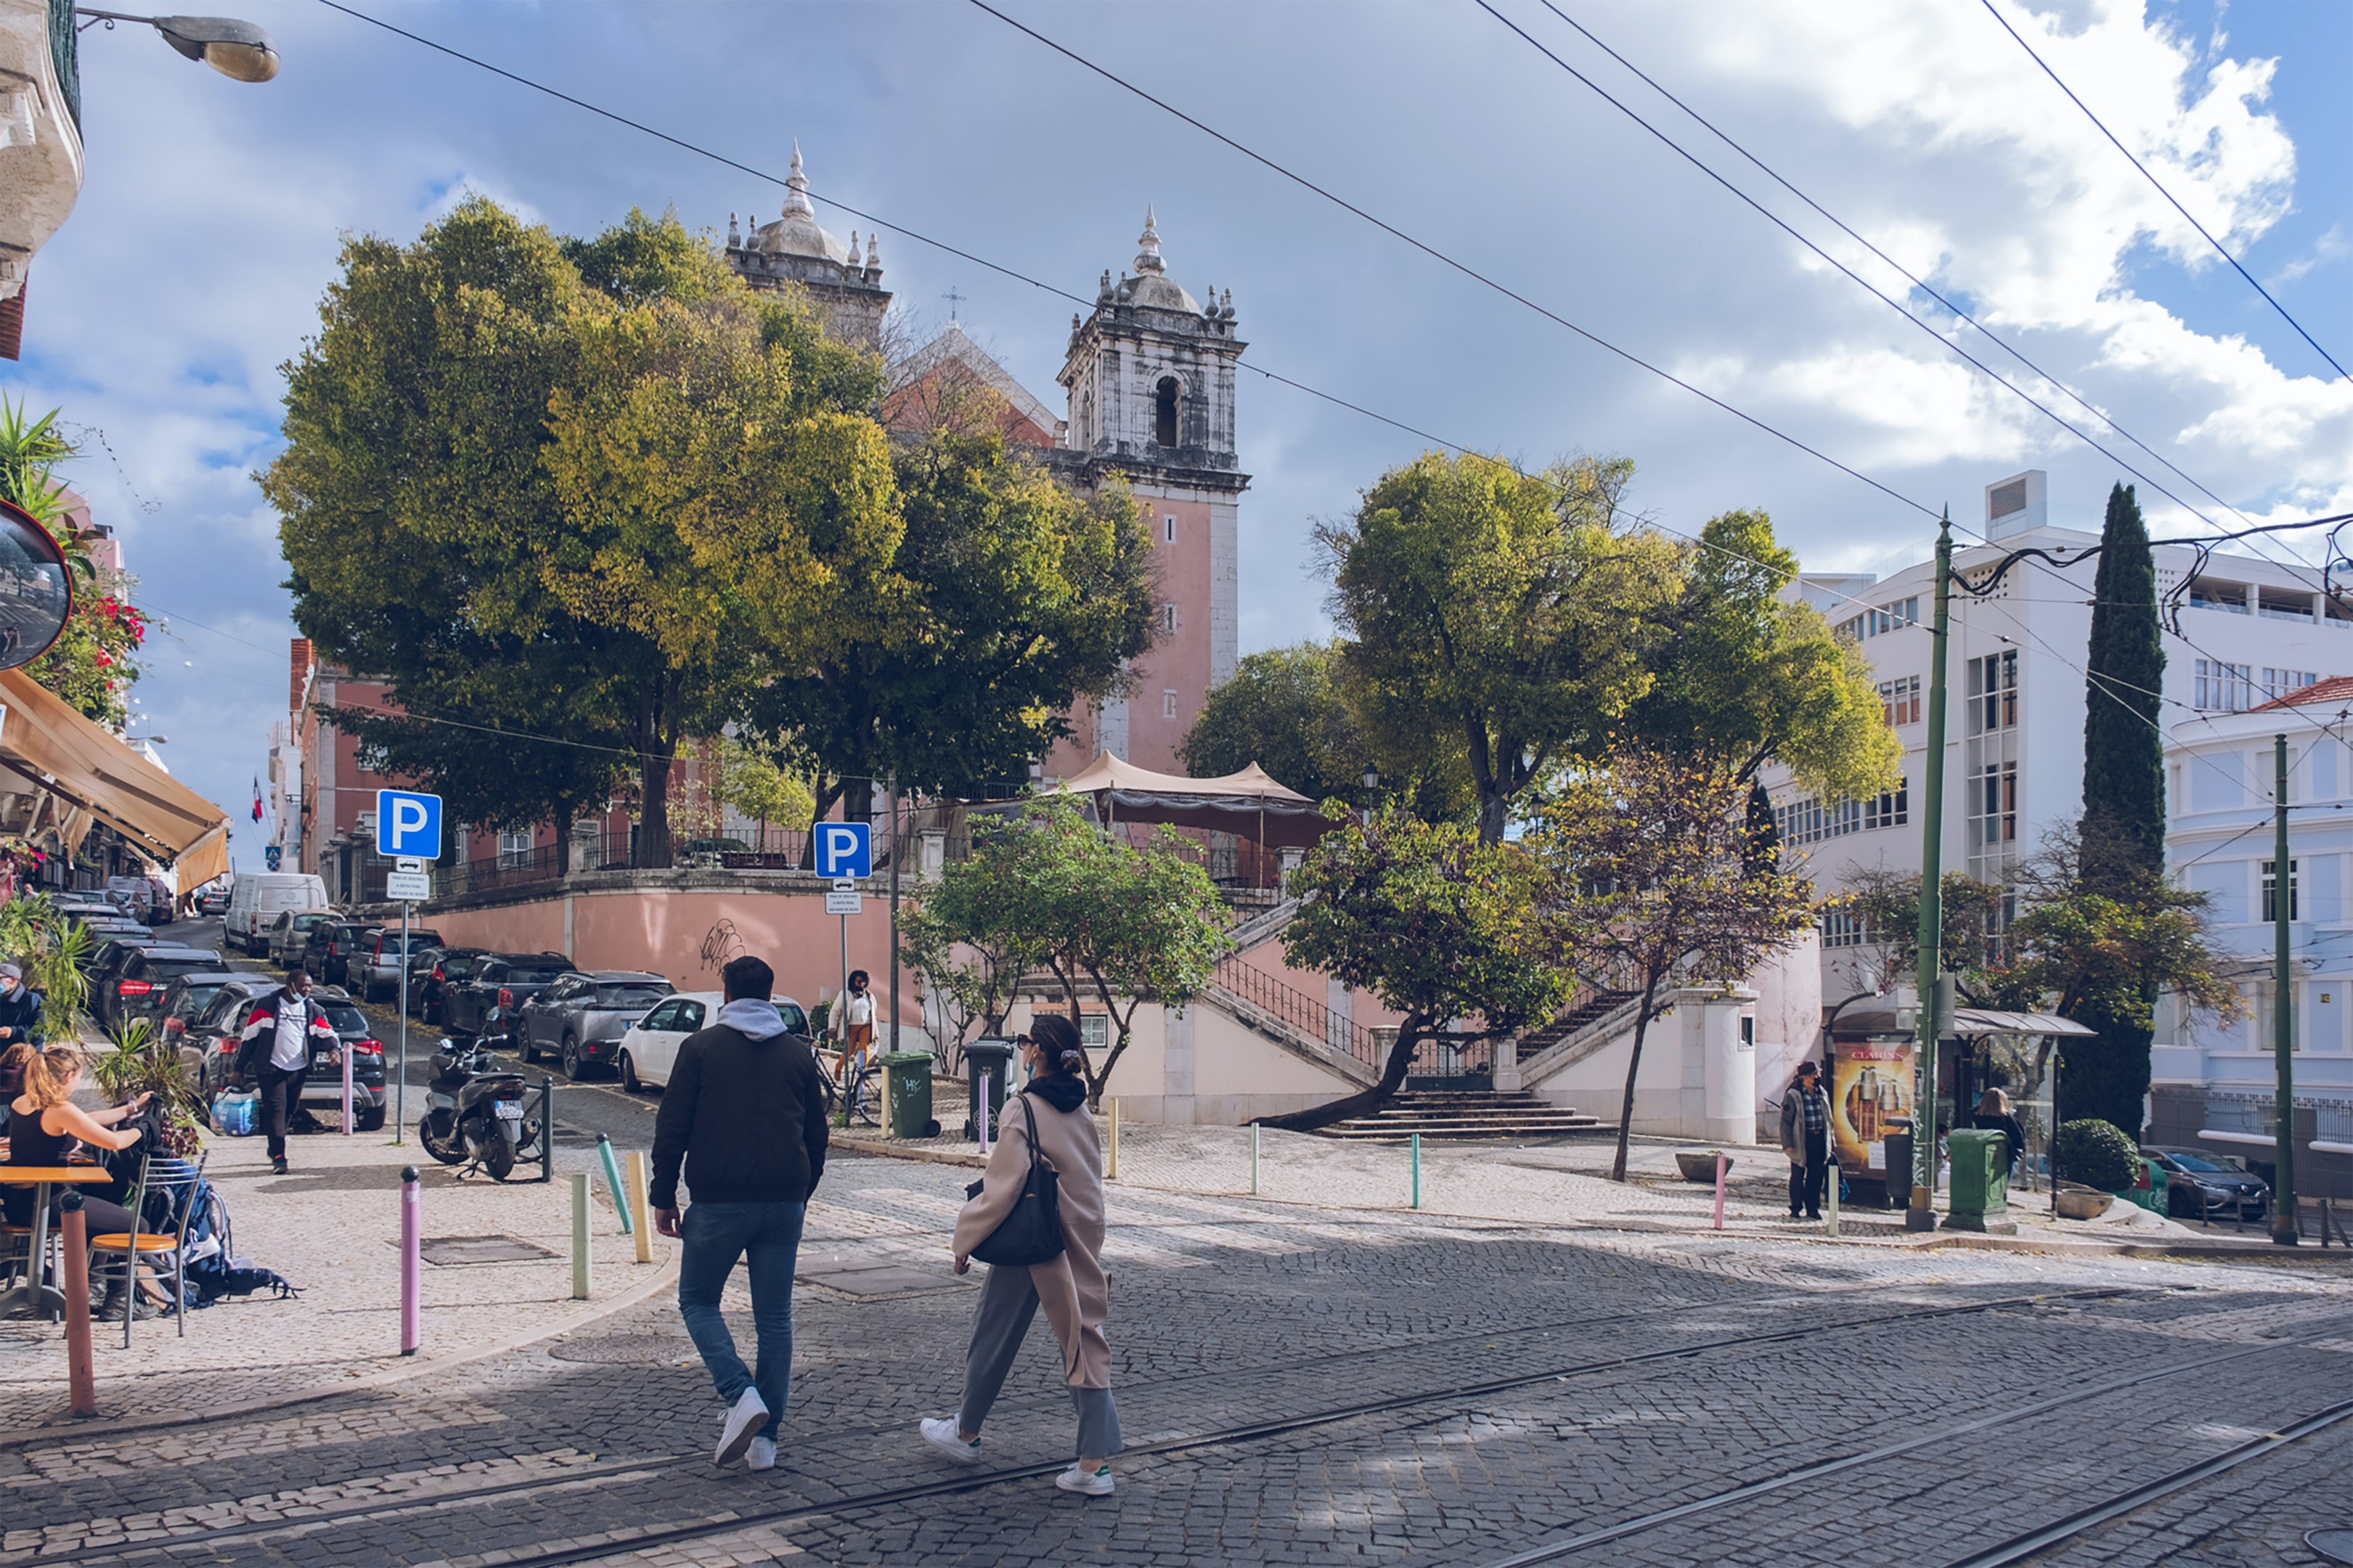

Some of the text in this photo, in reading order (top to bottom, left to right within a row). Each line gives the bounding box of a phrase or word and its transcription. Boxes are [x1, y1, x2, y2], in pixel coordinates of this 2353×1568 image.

[393, 798, 428, 849] P
[827, 828, 858, 873] P
[1851, 1051, 1903, 1060] CLARINS
